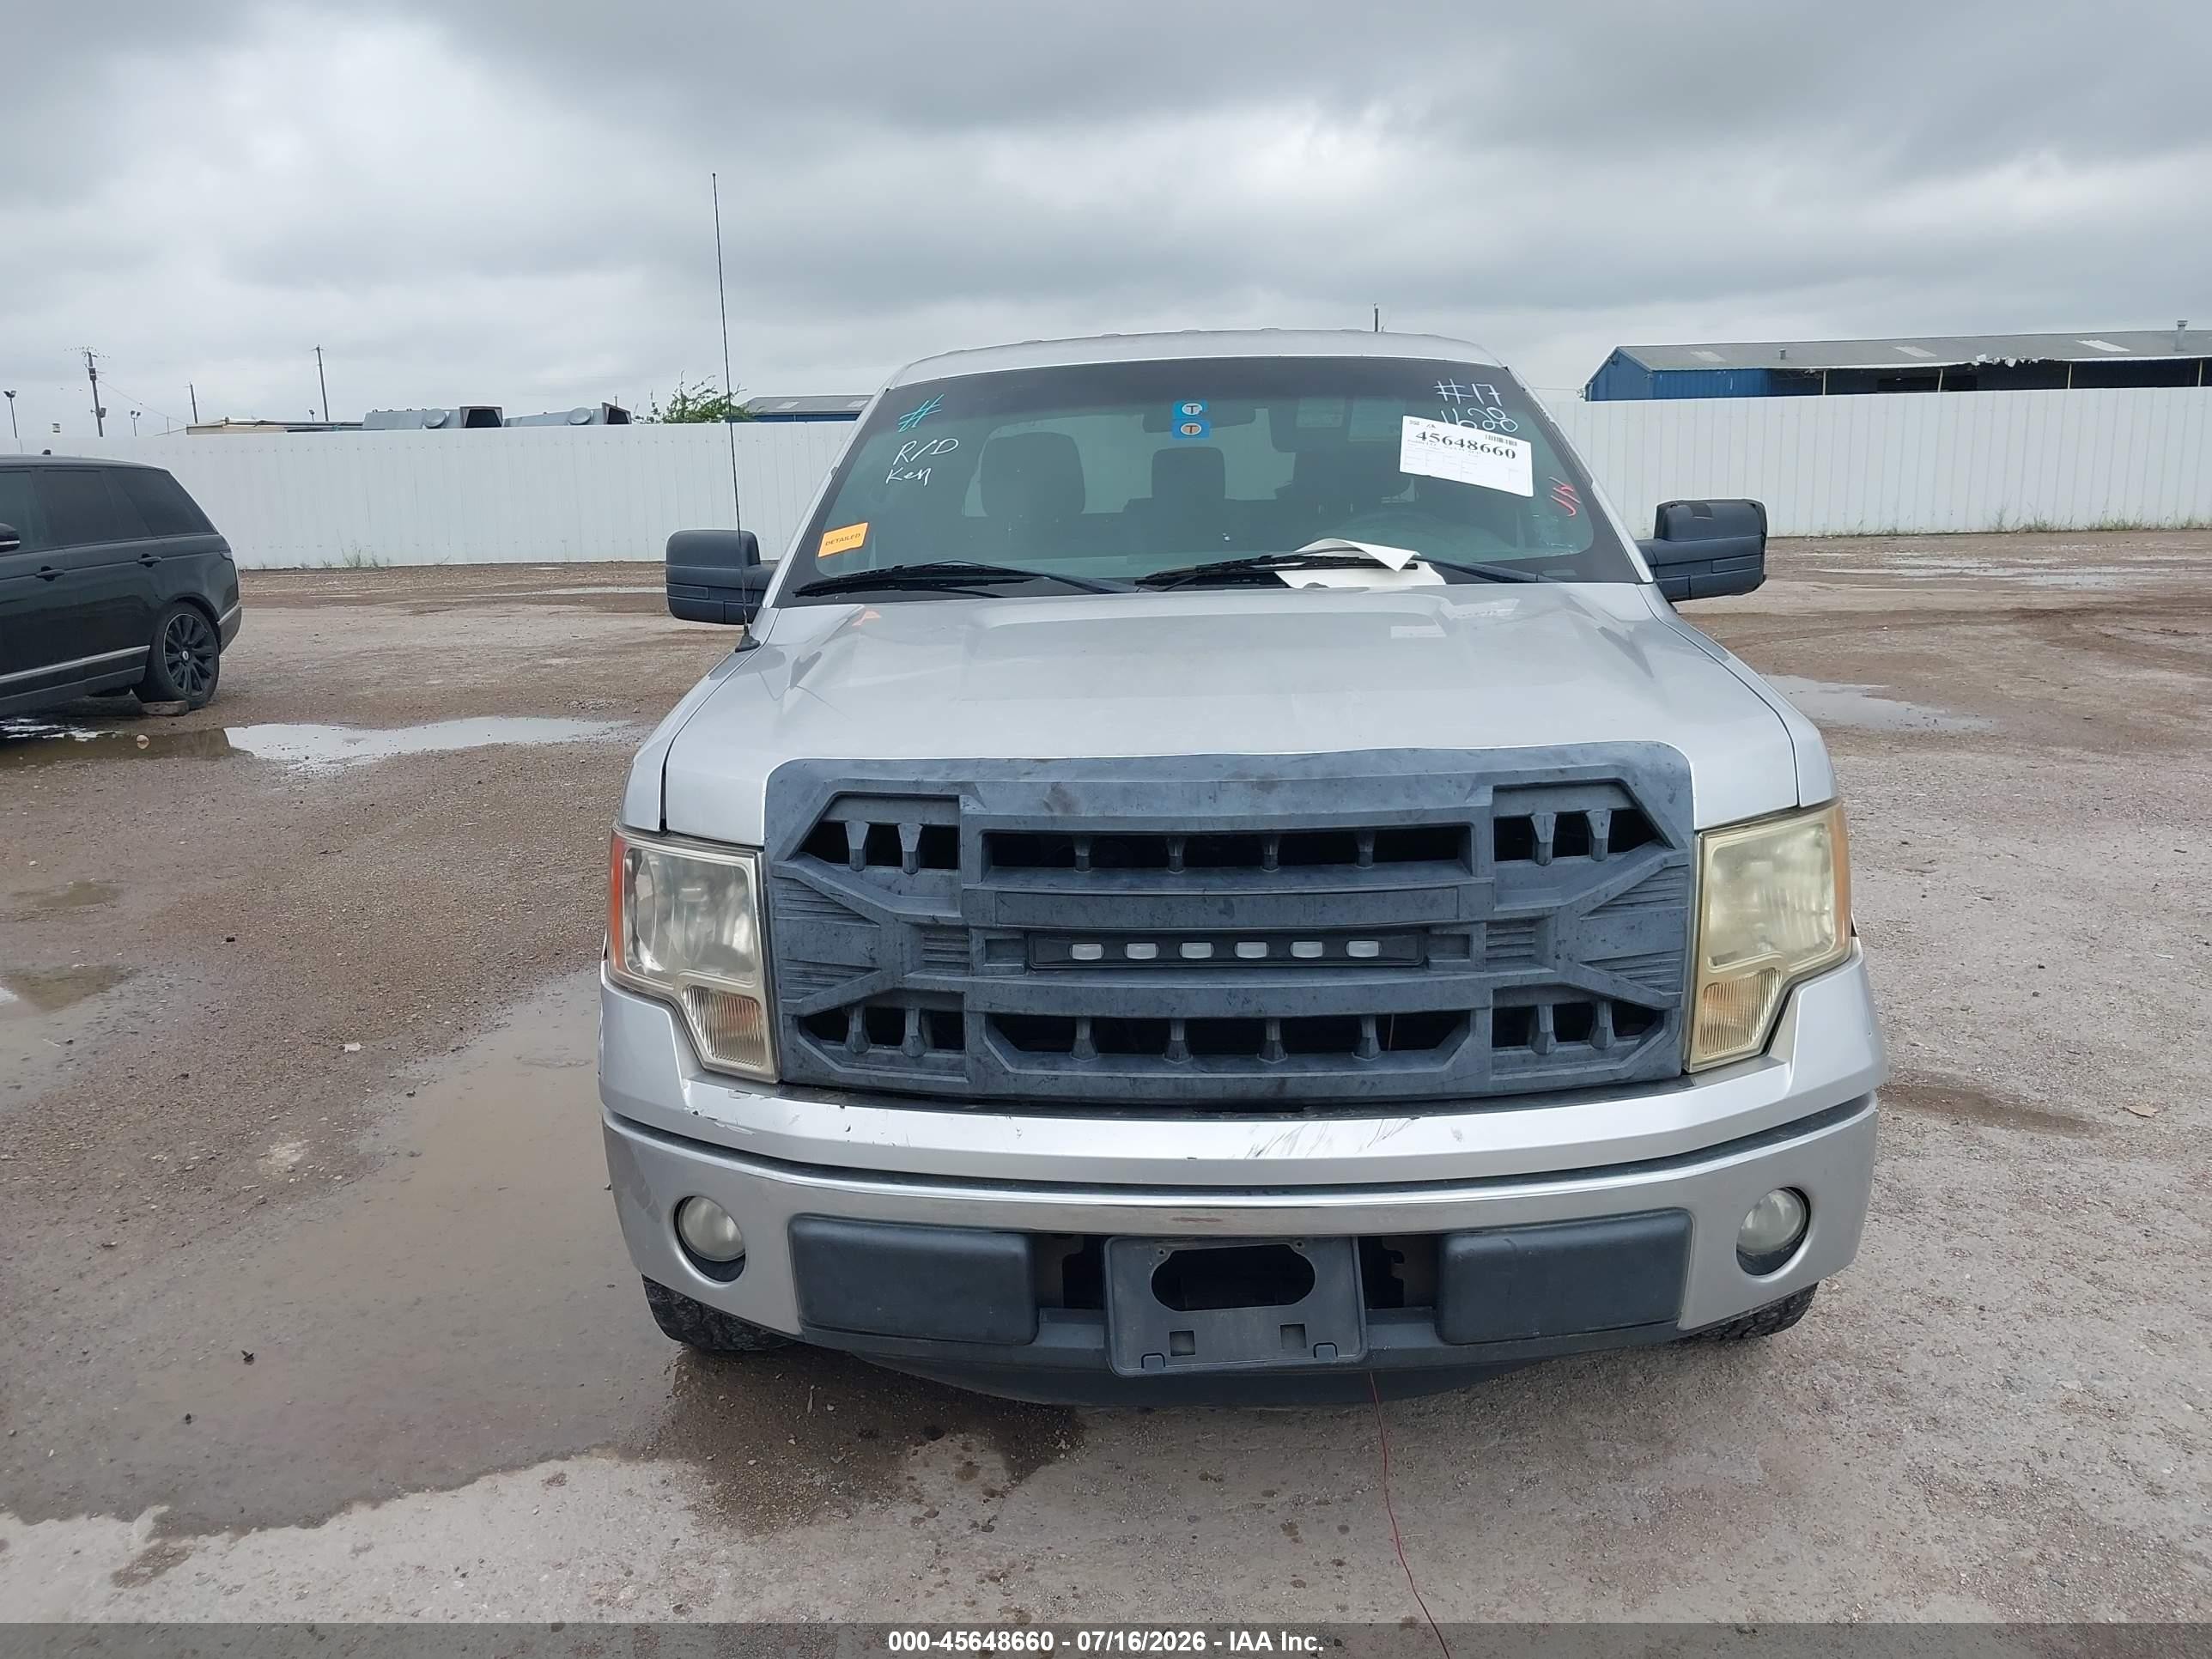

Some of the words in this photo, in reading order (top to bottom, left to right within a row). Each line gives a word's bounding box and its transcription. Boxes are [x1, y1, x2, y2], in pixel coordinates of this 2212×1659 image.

[1432, 378, 1503, 406] #17
[892, 438, 959, 465] R/D
[1415, 431, 1516, 459] 45648660
